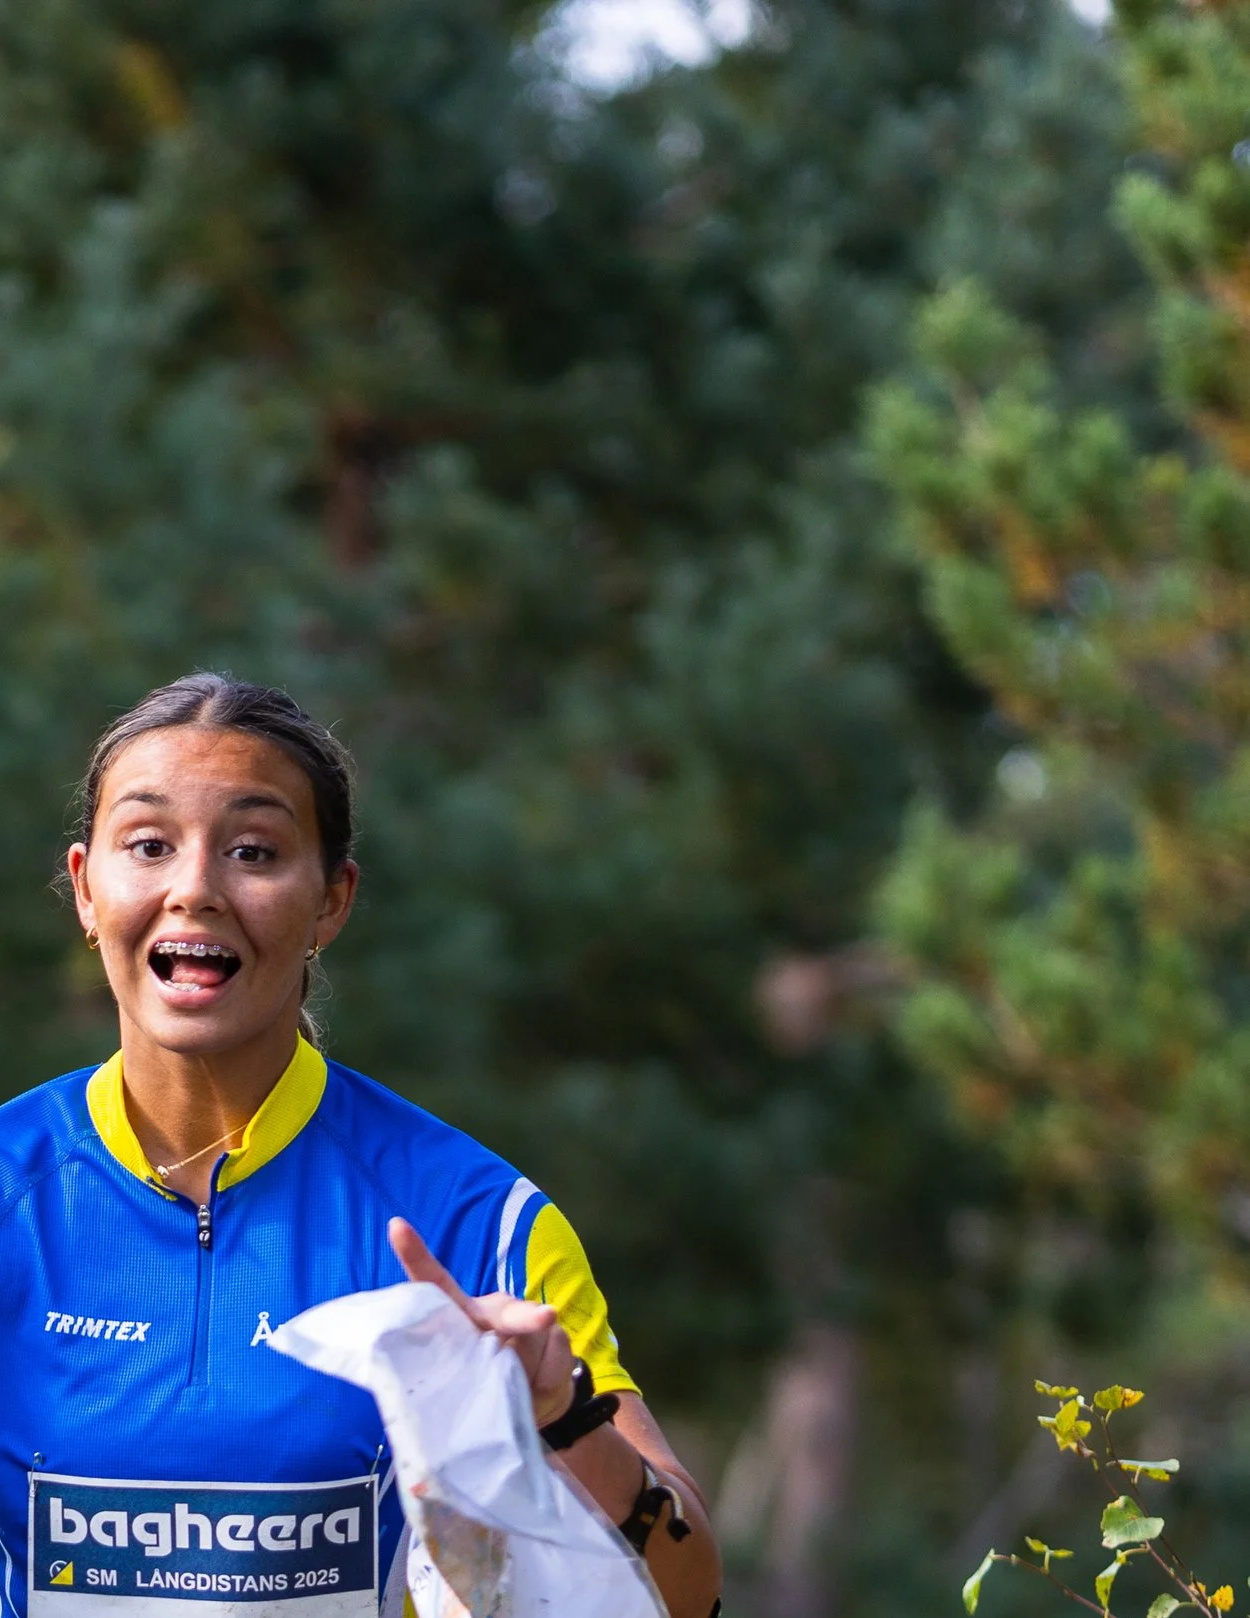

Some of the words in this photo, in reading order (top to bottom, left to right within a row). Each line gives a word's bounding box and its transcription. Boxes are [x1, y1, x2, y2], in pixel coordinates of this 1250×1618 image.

[44, 1311, 152, 1342] TRIMTEX
[50, 1497, 360, 1557] bagheera
[86, 1568, 117, 1587] SM
[136, 1567, 289, 1592] LÅNGDISTANS
[294, 1567, 340, 1588] 2025
